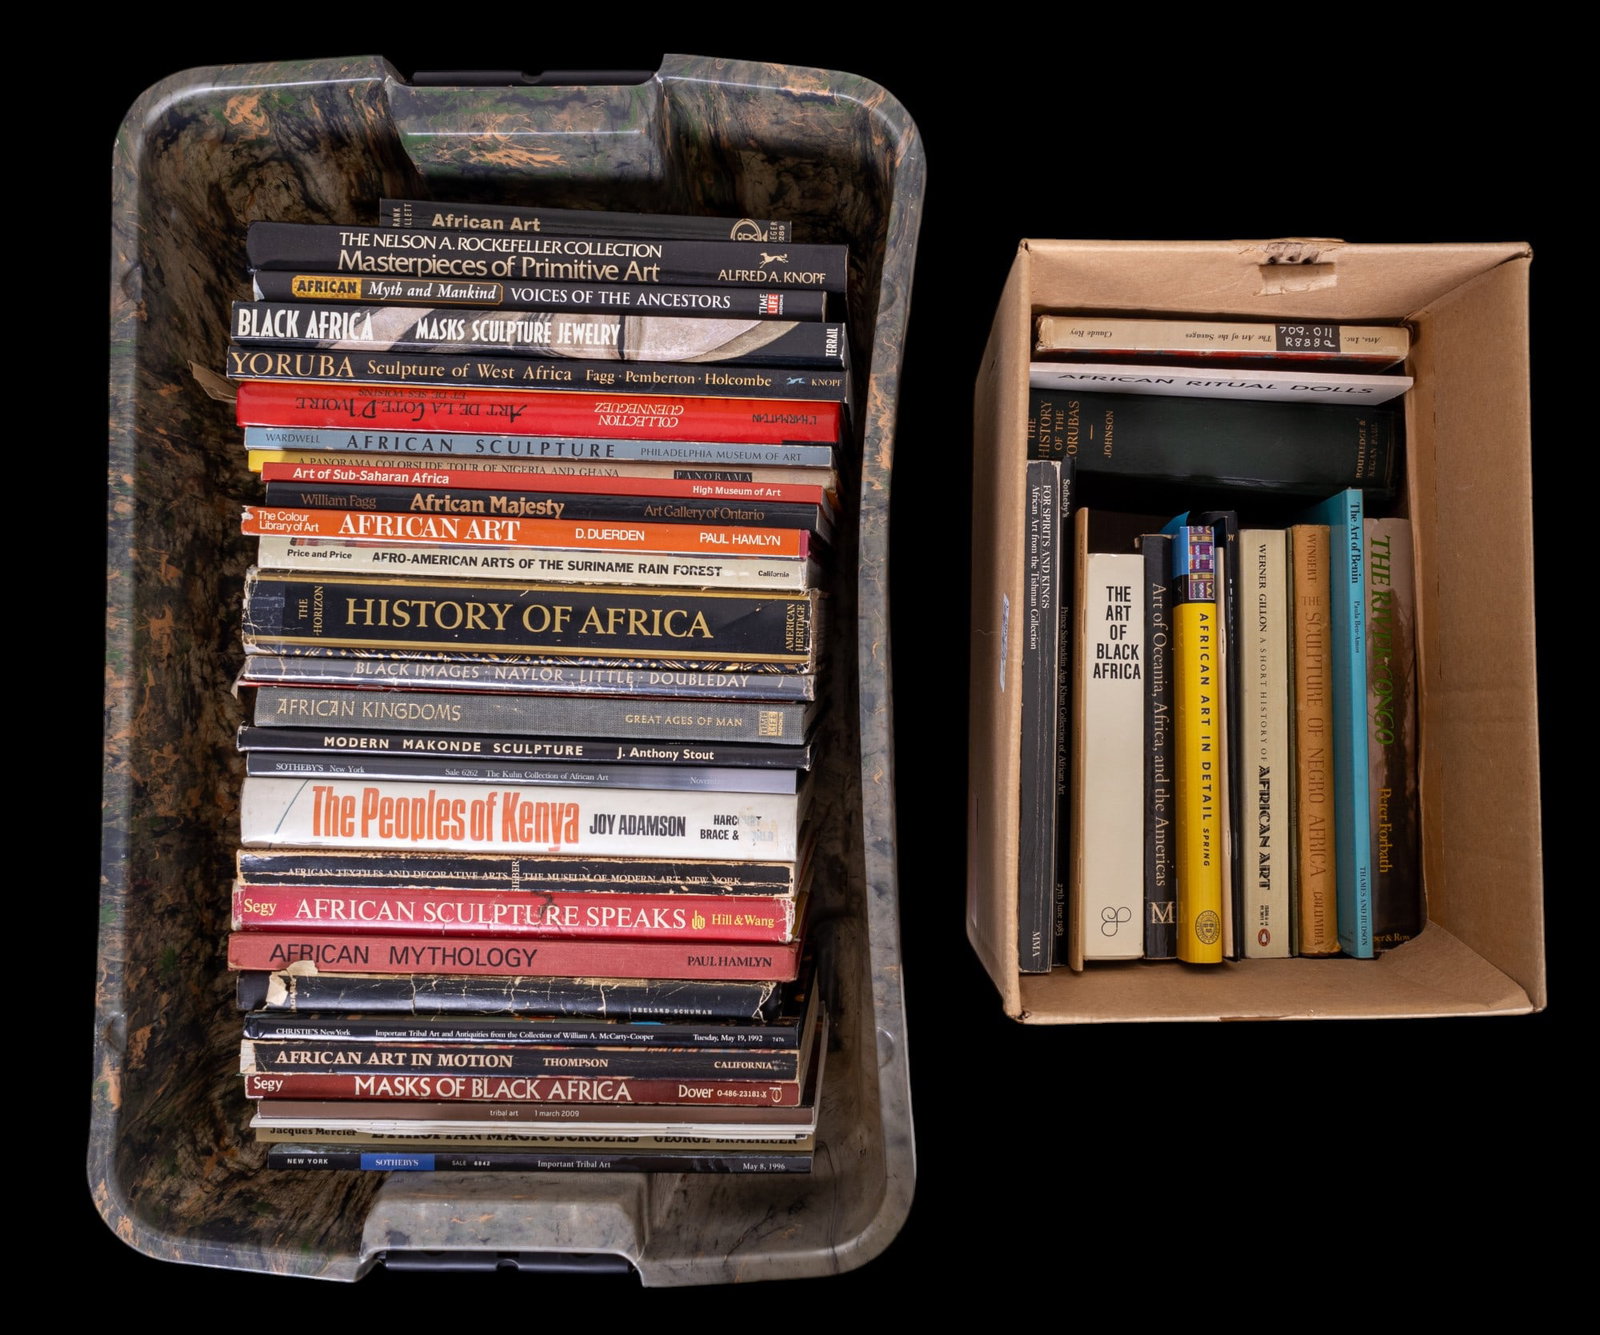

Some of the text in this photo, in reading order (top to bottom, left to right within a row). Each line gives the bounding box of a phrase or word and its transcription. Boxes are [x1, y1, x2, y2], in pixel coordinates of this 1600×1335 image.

[432, 213, 541, 233] African Art
[340, 232, 662, 258] THE NELSON ROCKEFELLER COLLECTION
[338, 250, 661, 282] Masterpieces Primitive Art
[718, 269, 826, 284] ALFRED KNOPF
[297, 280, 731, 309] AFRICAN Mankind VOICES THE ANCESTORS
[759, 293, 768, 315] TIME
[769, 294, 778, 314] LIFE
[237, 308, 621, 346] BLACK AFRICA MASKS SCULPTURE JEWELRY
[1087, 330, 1113, 338] Claude
[1185, 333, 1214, 341] Savages
[825, 328, 838, 356] TERRAIL
[231, 351, 771, 387] YORUBA Sculpture West Africa Fagg Pemberton Holcombe
[1058, 374, 1374, 394] AFRICAN RITUAL DOLLS
[459, 403, 480, 415] DE
[594, 402, 685, 415] GUENNEGUEZ
[1056, 410, 1064, 432] THE
[598, 415, 679, 429] COLLECTION
[1027, 417, 1036, 439] THE
[1038, 400, 1052, 458] HISTORY
[1104, 411, 1114, 458] JOHNSON
[346, 436, 762, 460] AFRICAN SCULPTURE PHILADELPHIA MUSEUM
[293, 467, 449, 484] Art Sub-Saharan Africa
[676, 472, 752, 482] PANORAMA
[715, 486, 752, 497] Museum
[1062, 479, 1071, 518] Sotheby's
[278, 512, 309, 523] Colour
[301, 493, 565, 519] William Fagg African Majesty
[1042, 485, 1051, 548] FOR SPIRITS
[260, 521, 292, 533] Library
[338, 514, 782, 546] AFRICAN ART PAUL HAMLYN
[1350, 501, 1361, 584] The Benin
[287, 549, 669, 575] Price Price AFRO-AMERICAN ARTS SURINAME RAIN
[1259, 544, 1267, 589] WERNER
[1106, 586, 1131, 602] THE
[299, 598, 308, 619] THE
[313, 585, 324, 634] HORIZON
[345, 597, 714, 640] HISTORY OF AFRICA
[1106, 605, 1130, 621] ART
[784, 603, 795, 652] AMERICAN
[796, 604, 806, 652] HERITAGE
[1030, 608, 1040, 650] Collection
[1110, 625, 1127, 641] OF
[1371, 534, 1395, 745] THE CONGO
[1096, 644, 1139, 660] BLACK
[355, 662, 749, 688] BLACK IMAGES NAYLOR LITTLE DOUBLEDAY
[1093, 663, 1141, 679] AFRICA
[277, 699, 692, 726] AFRICAN KINGDOMS GREAT AGES
[1199, 613, 1211, 821] AFRICAN ART IN DETAIL
[1152, 583, 1170, 887] Art and the Americas
[1305, 612, 1326, 878] SCULPTURE NEGRO AFRICA
[324, 736, 714, 761] MODERN MAKONDE SCULPTURE Anthony Stout
[568, 773, 594, 782] African
[312, 786, 687, 851] The Peoples Kenya JOY ADAMSON
[1259, 765, 1271, 848] AFRICAN
[700, 829, 729, 840] BRACE
[1379, 823, 1393, 873] Forbath
[289, 868, 332, 878] AFRICAN
[1259, 852, 1271, 891] ART
[244, 898, 687, 930] Segy AFRICAN SCULPTURE SPEAKS
[1150, 902, 1175, 924] M
[389, 945, 772, 969] MYTHOLOGY PAUL HAMLYN
[1032, 931, 1041, 958] MMA
[376, 1029, 408, 1038] Important
[275, 1050, 609, 1069] AFRICAN MOTION THOMPSON
[254, 1077, 713, 1102] Segy MASKS AFRICA Dover
[490, 1109, 507, 1117] tribal
[537, 1161, 574, 1170] Important
